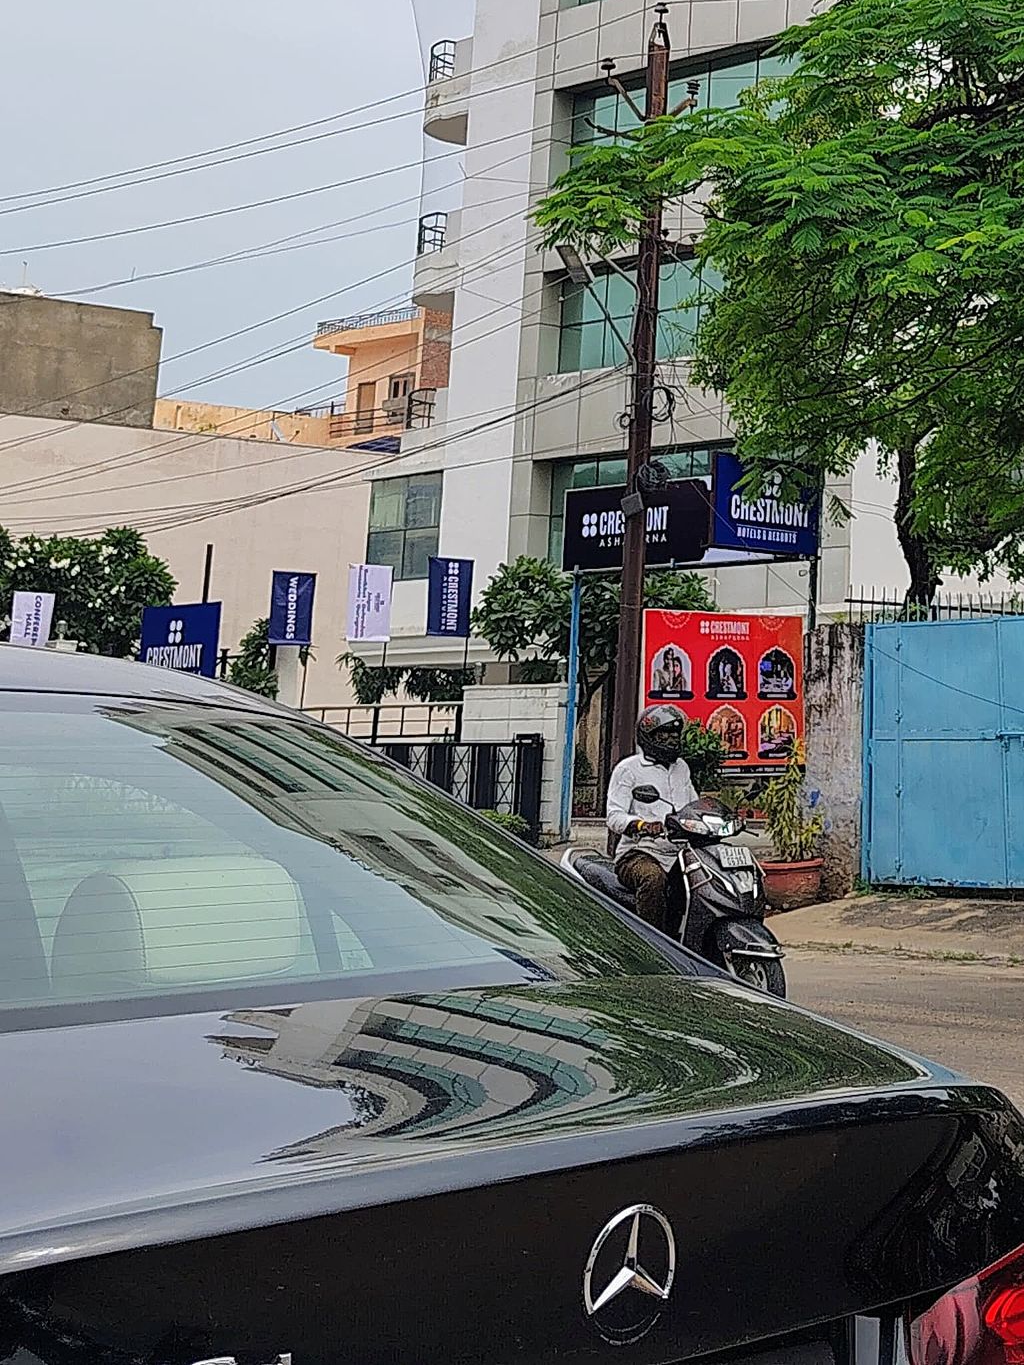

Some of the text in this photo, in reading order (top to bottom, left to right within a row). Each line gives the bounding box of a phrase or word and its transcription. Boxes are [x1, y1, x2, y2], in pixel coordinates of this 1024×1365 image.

[600, 506, 669, 536] CRESONT
[731, 494, 809, 528] CRESTMONT
[285, 576, 299, 640] WEDDINGS
[446, 576, 459, 632] CRESTMONT
[24, 613, 32, 638] HALL
[146, 644, 203, 669] CRESTMONT
